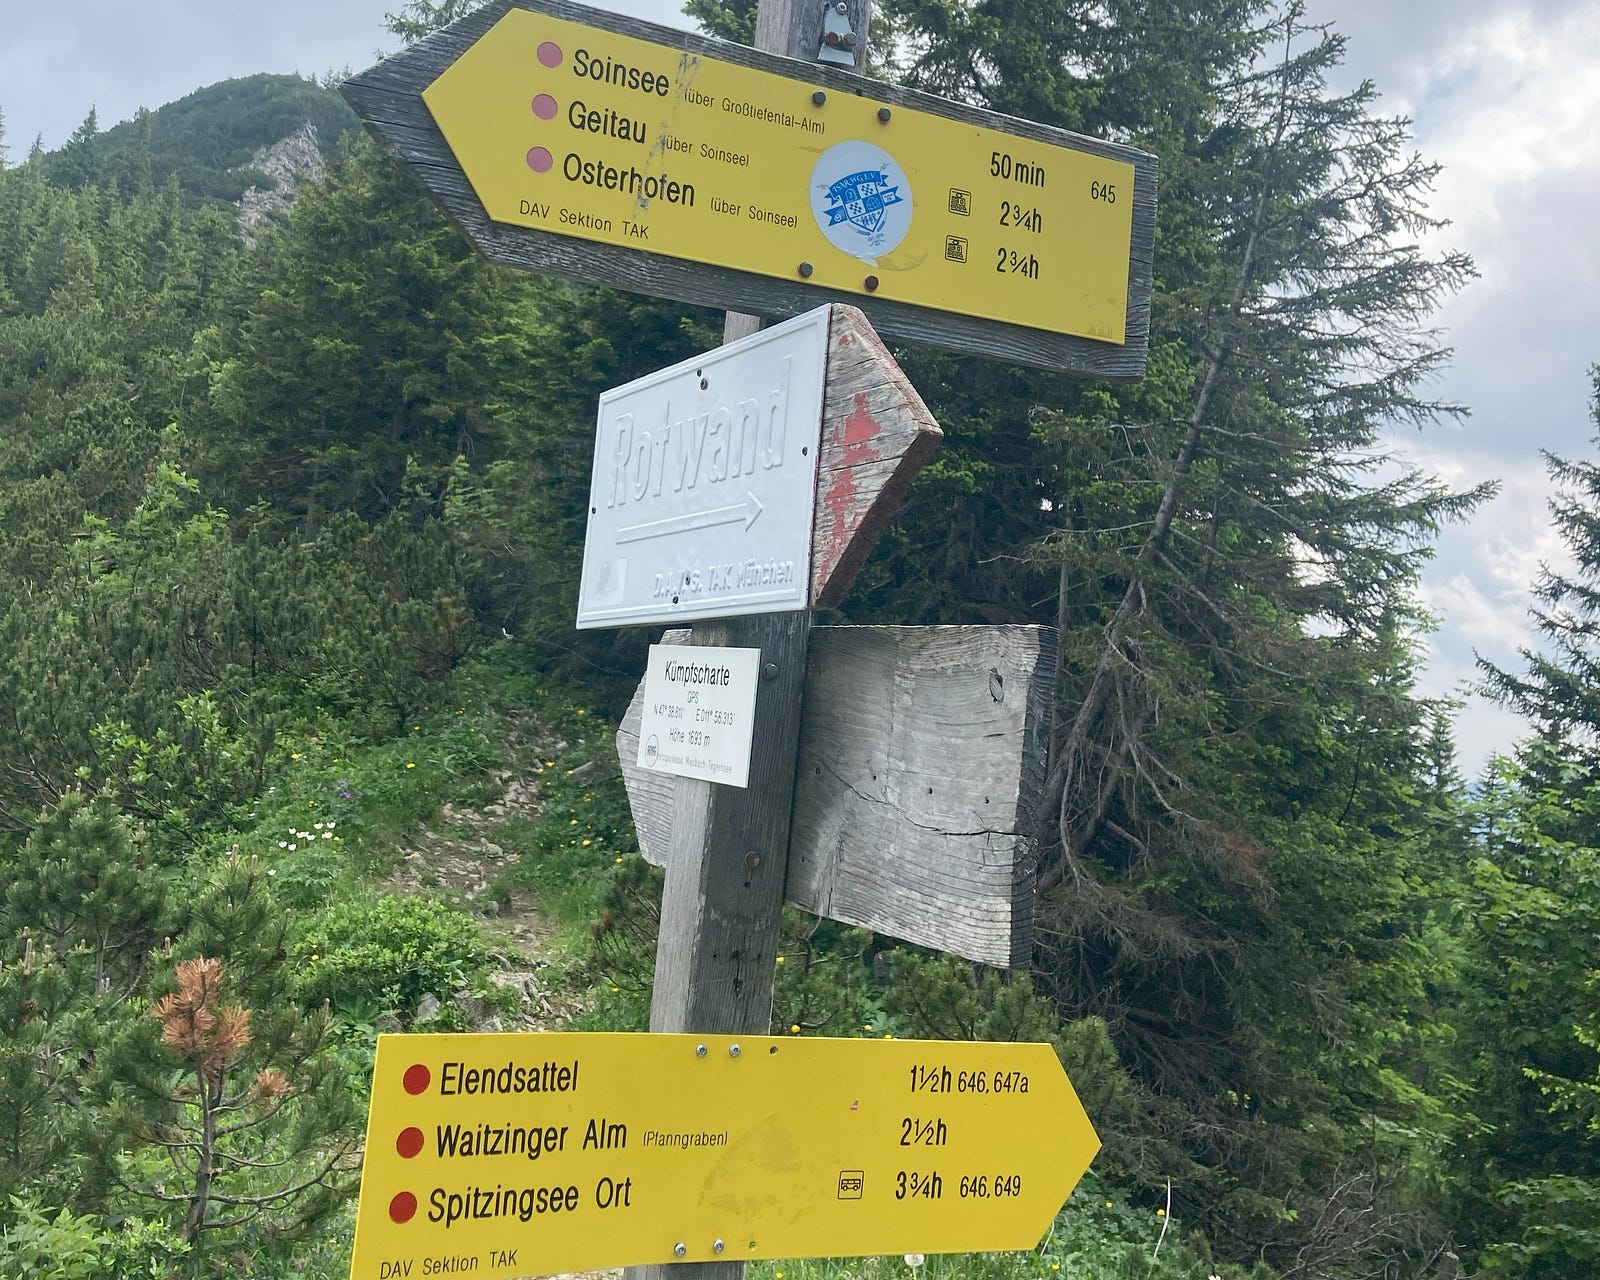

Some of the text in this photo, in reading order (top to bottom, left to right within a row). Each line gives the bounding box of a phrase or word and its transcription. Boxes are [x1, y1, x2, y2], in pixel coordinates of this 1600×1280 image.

[573, 49, 669, 97] Soinsee
[684, 89, 714, 107] (über
[568, 100, 647, 144] Geitau
[700, 143, 750, 167] Soinsee)
[990, 152, 1045, 187] 50 min
[563, 153, 798, 228] Osterhofen (über Soinsee)
[1091, 181, 1116, 204] 645
[519, 200, 650, 240] DAV Sektion TAK
[607, 353, 792, 509] Rotwand
[737, 556, 795, 589] München
[665, 660, 730, 686] Kümpfscharte
[687, 690, 699, 704] GPS
[669, 727, 710, 747] Höhe 1693 m
[440, 1060, 578, 1096] Elendsattel
[436, 1118, 947, 1160] Waitzinger Alm (Pfanngraben) 2½h
[428, 1184, 579, 1229] Spitzingsee
[595, 1177, 632, 1209] Ort
[379, 1250, 518, 1279] DAV Sektion TAK
